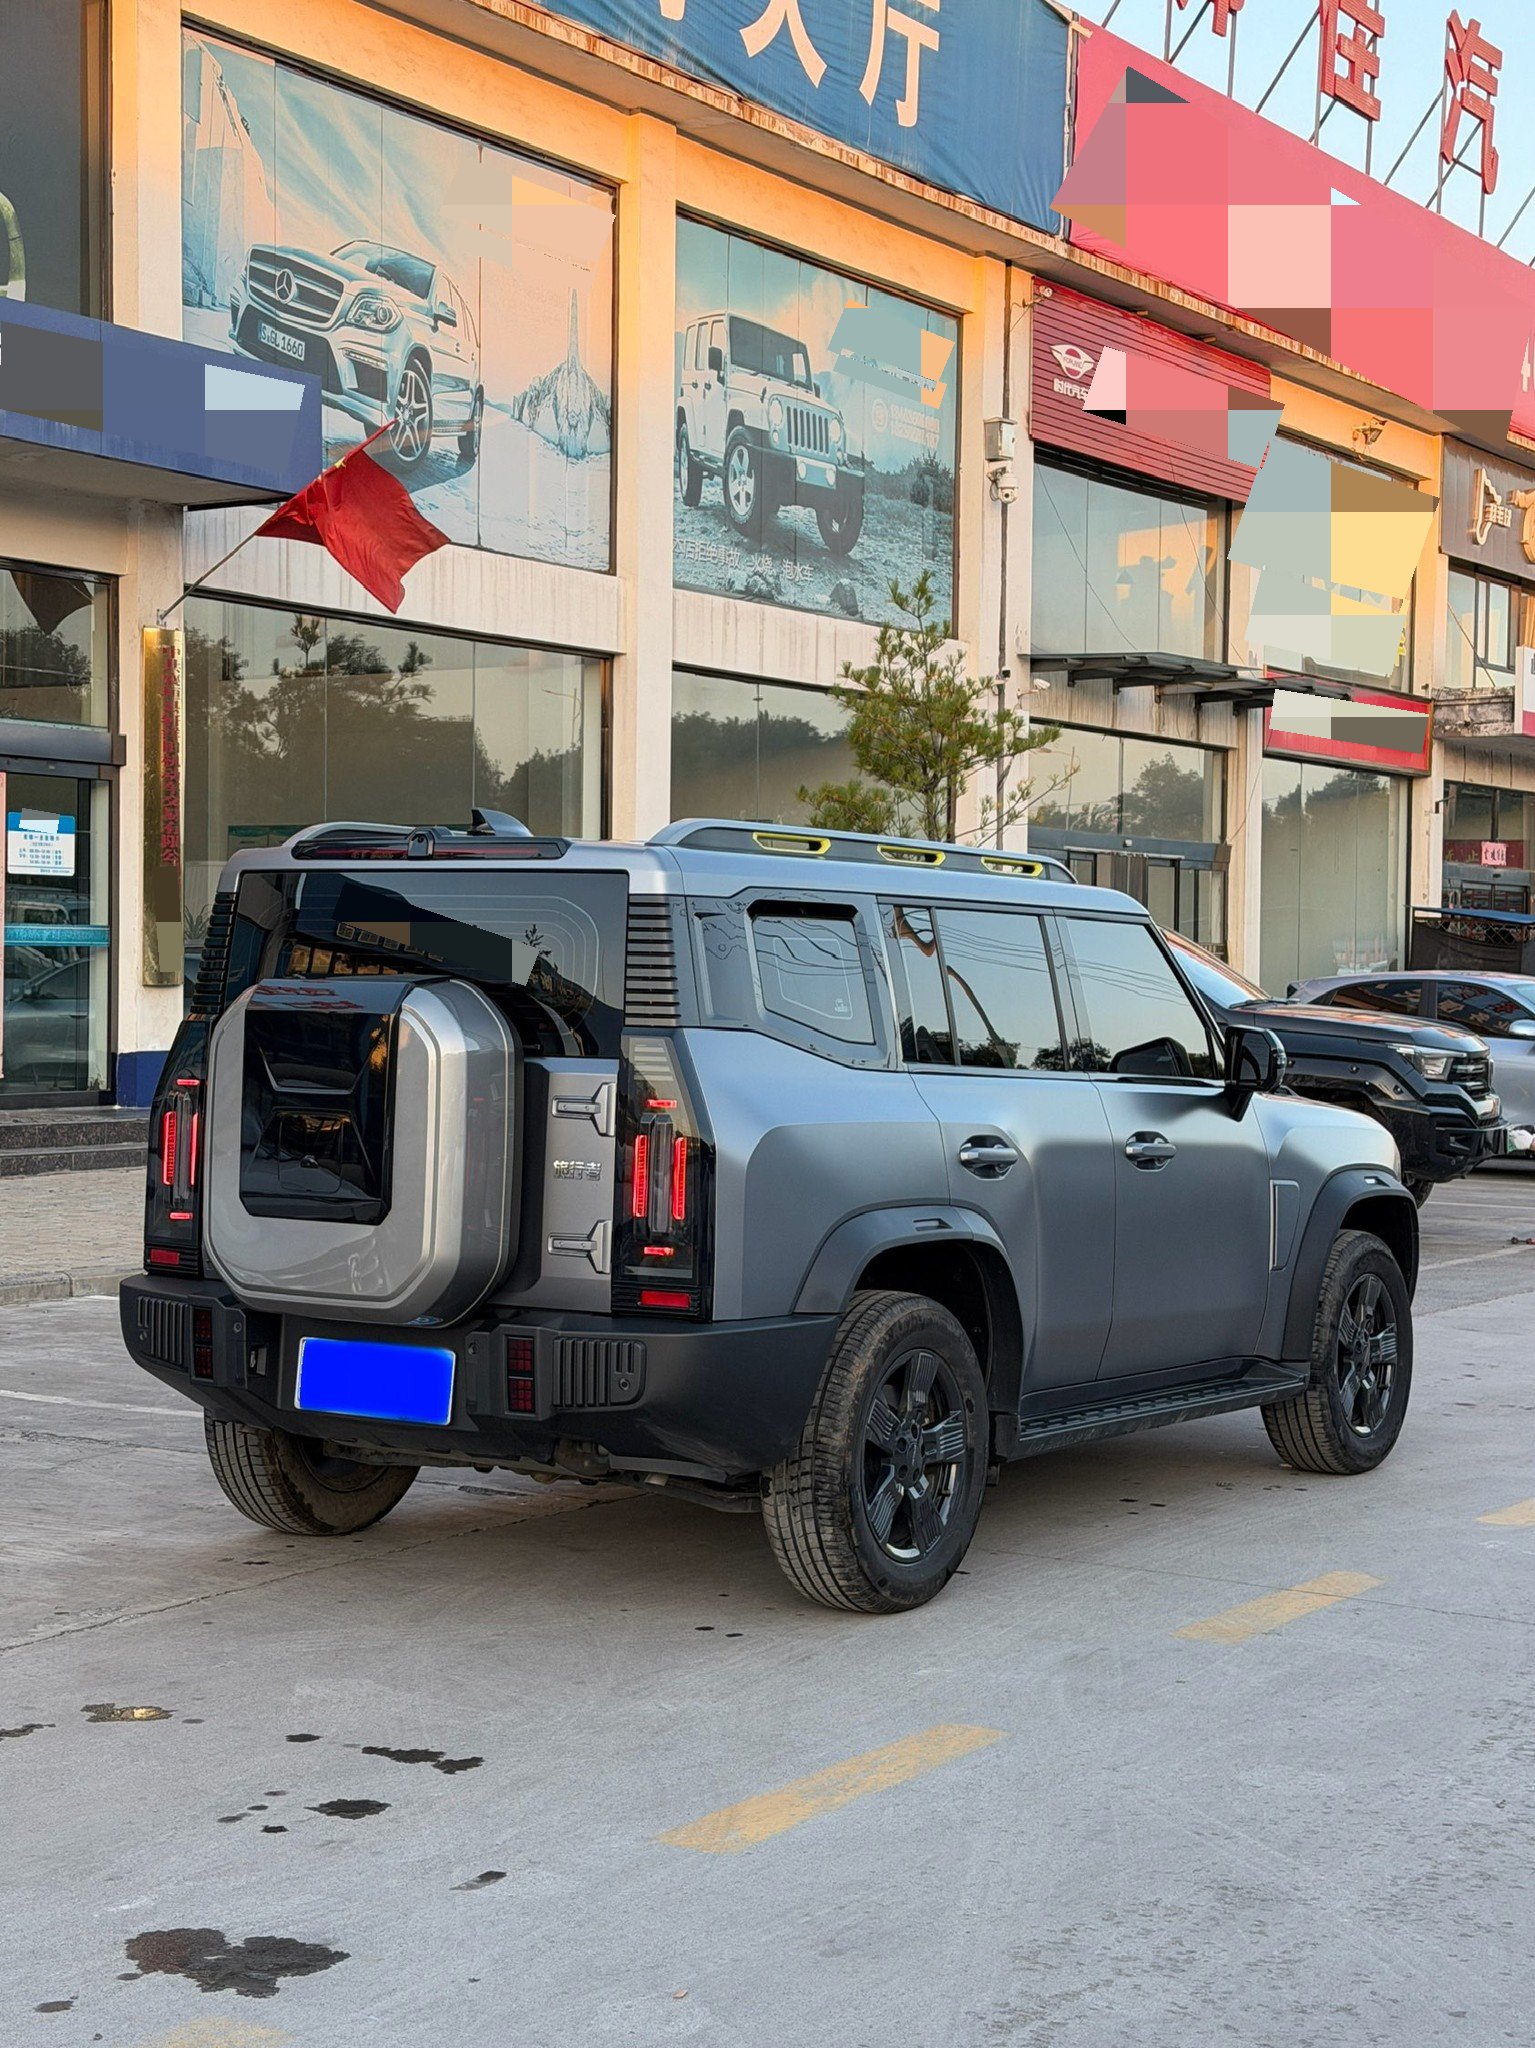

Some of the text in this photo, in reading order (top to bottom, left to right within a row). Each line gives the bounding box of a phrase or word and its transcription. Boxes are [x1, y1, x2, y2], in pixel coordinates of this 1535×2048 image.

[1176, 0, 1503, 195] 佳汽
[281, 336, 304, 358] 1660
[552, 1160, 602, 1181] 旅行者
